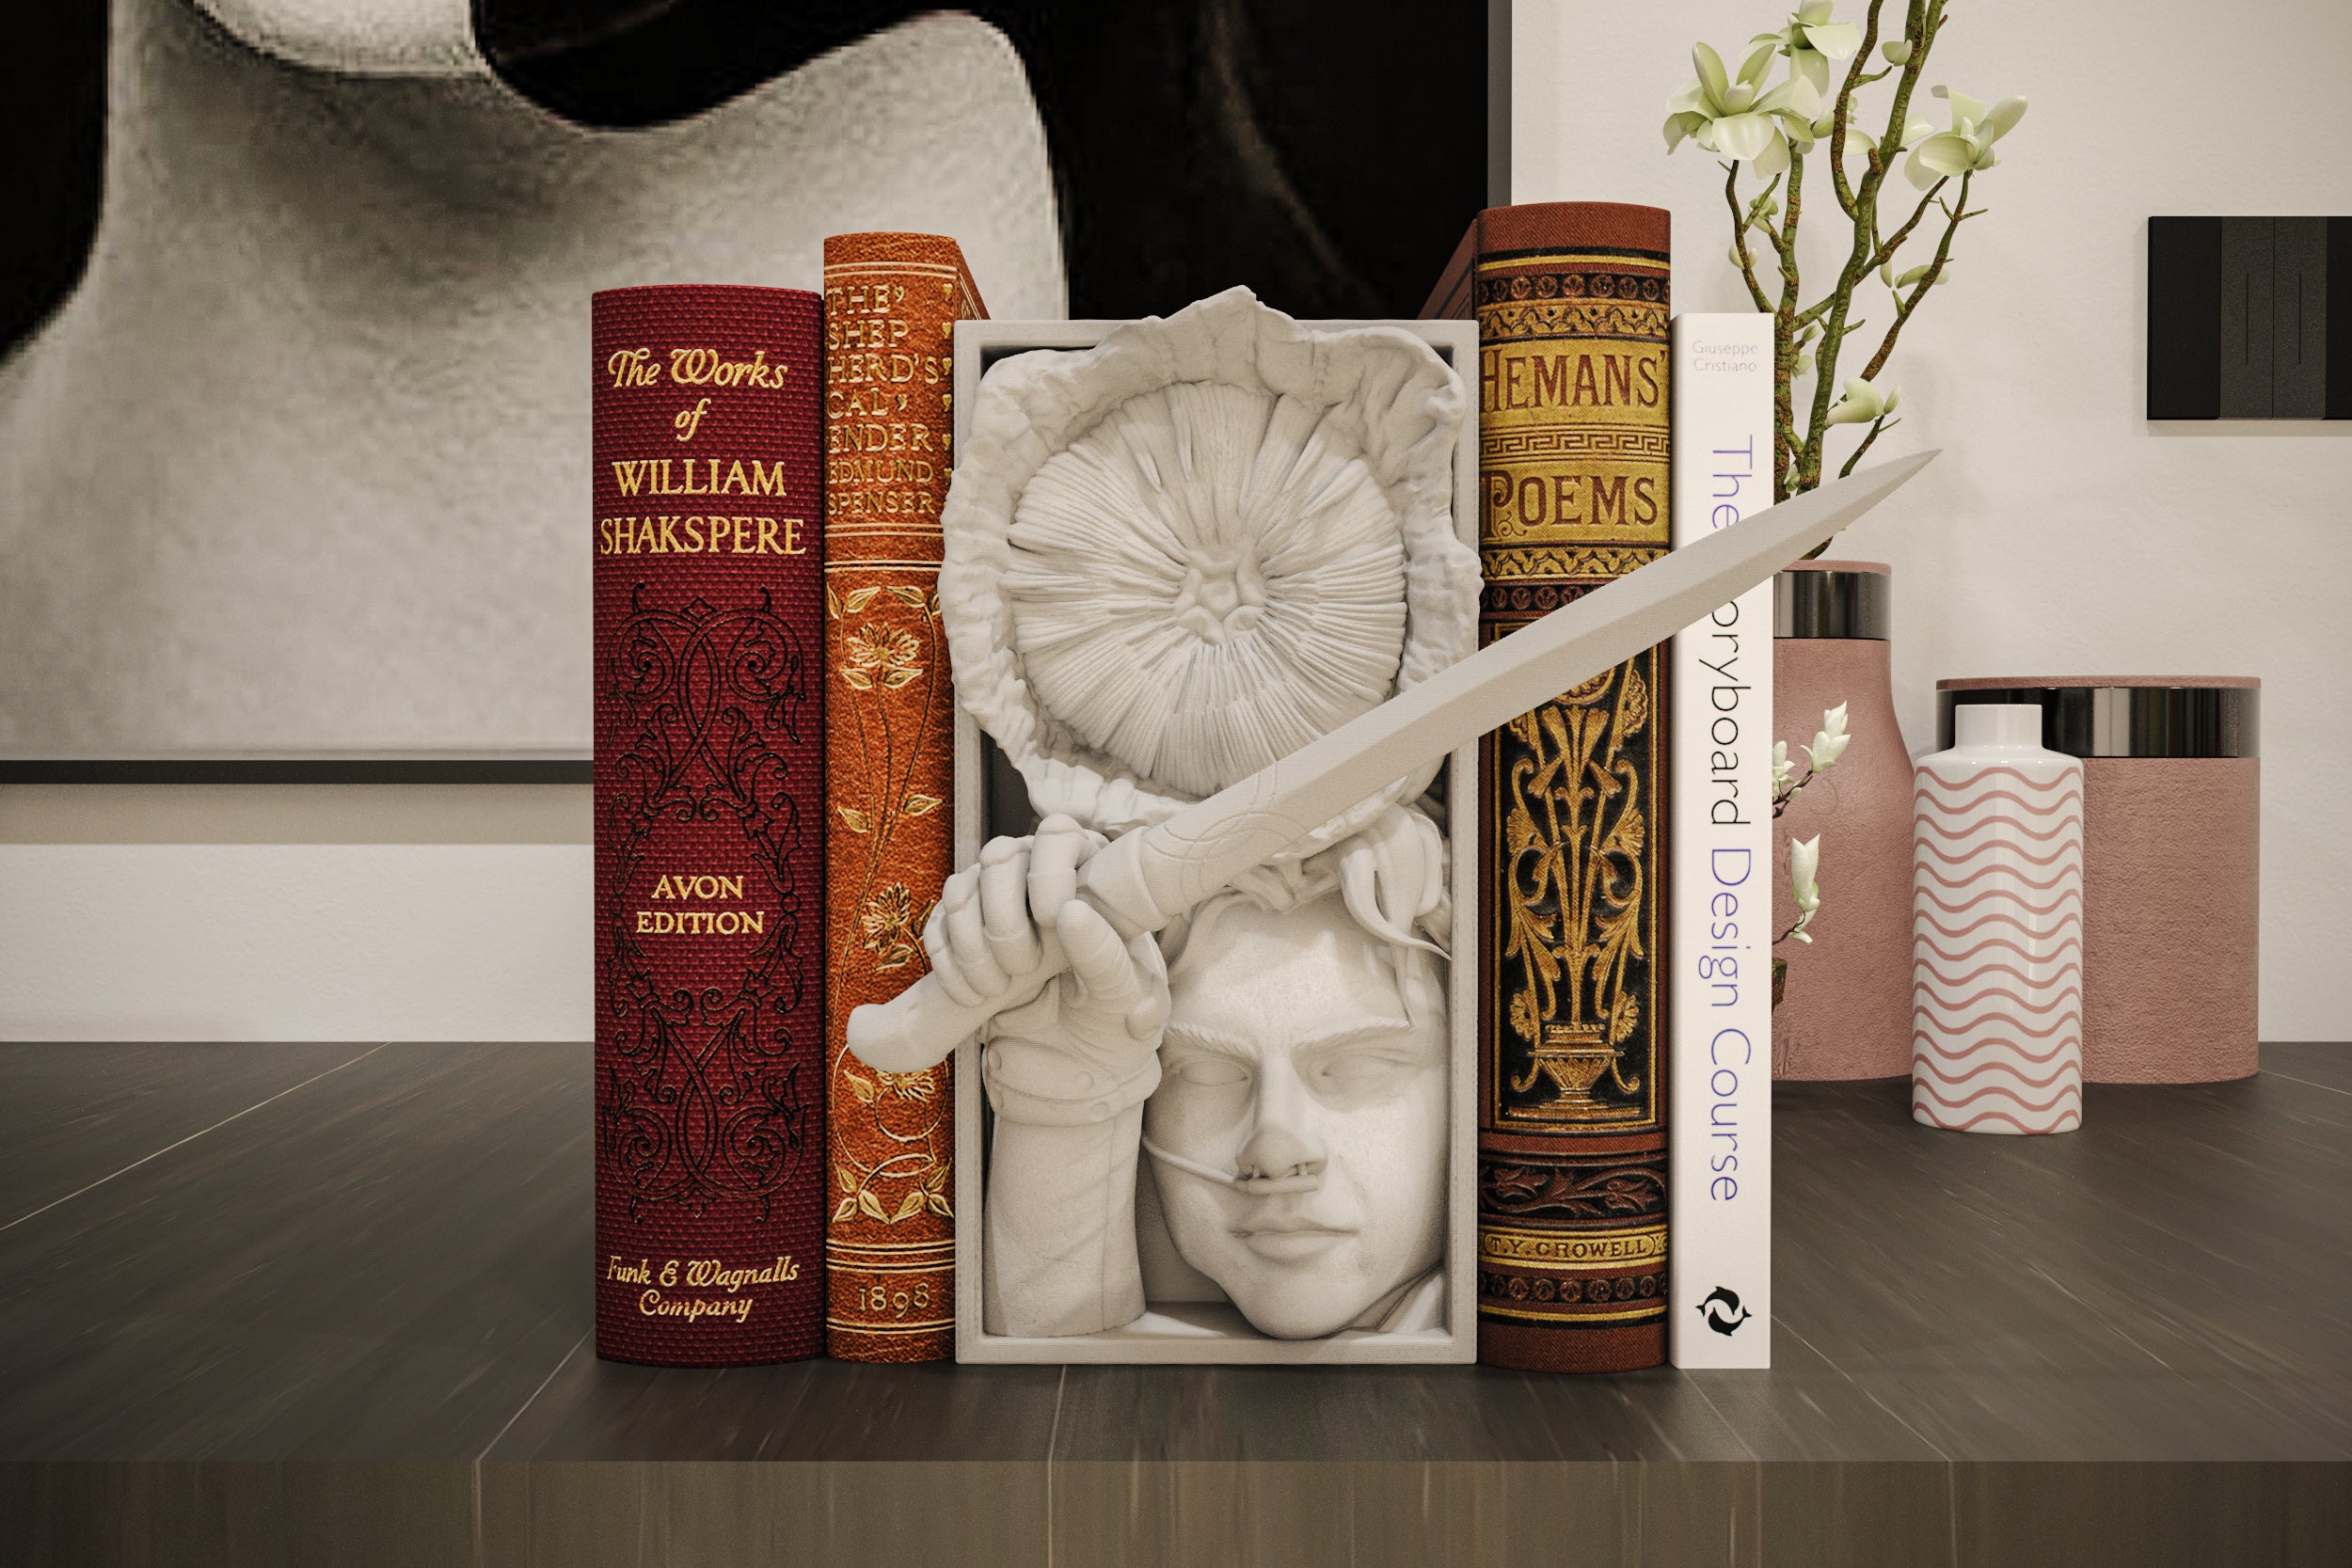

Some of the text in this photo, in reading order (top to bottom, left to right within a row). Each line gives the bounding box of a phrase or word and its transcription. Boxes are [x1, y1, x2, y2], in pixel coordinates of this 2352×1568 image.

[827, 320, 910, 351] SHEP
[1692, 340, 1758, 357] Giuseppe
[608, 347, 788, 390] The Works
[827, 353, 940, 385] HERD'S
[1480, 349, 1666, 413] HEMANS'
[1693, 357, 1756, 372] Cristiano
[675, 398, 712, 443] of
[828, 423, 933, 453] ENDER
[612, 459, 787, 497] WILLIAM
[828, 460, 934, 484] EDMUND
[827, 491, 936, 515] SPENSER
[1480, 469, 1659, 539] POEMS
[600, 516, 806, 555] SHAKSPERE
[1698, 434, 1753, 1201] The oryboard Design Course
[650, 874, 744, 900] AVON
[636, 911, 765, 935] EDITION
[1535, 1238, 1646, 1259] CROWELL
[607, 1255, 800, 1292] Funk & Wagnalls
[639, 1289, 753, 1323] Company
[859, 1282, 930, 1319] 1898
